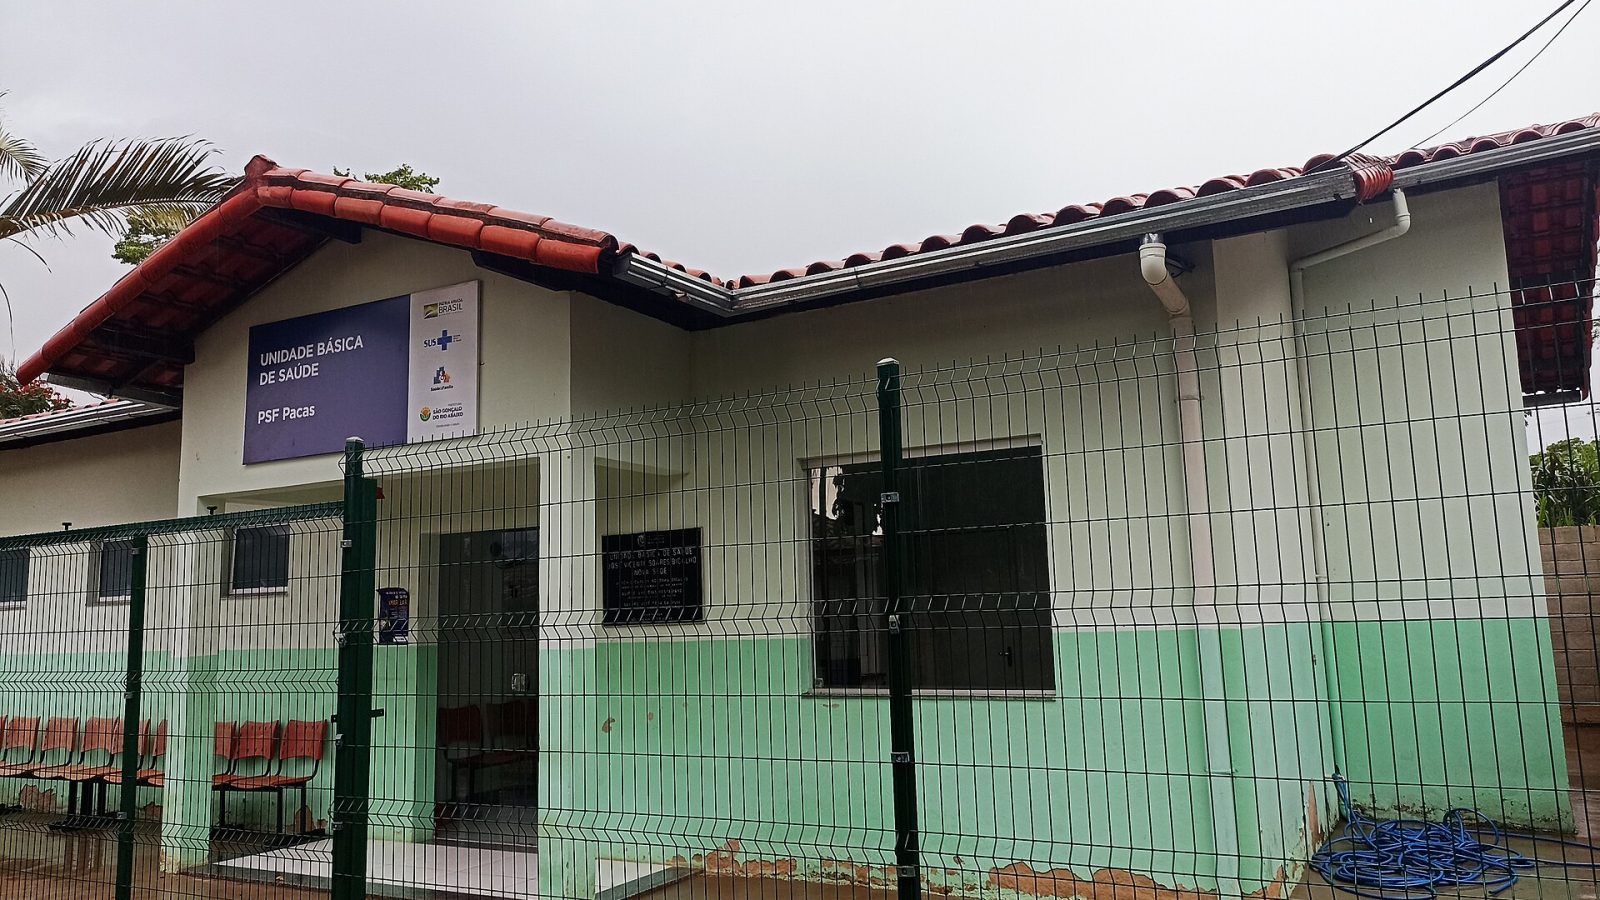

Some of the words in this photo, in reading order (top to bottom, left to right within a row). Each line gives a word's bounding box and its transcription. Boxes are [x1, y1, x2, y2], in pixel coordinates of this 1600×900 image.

[439, 303, 463, 313] BRASIL
[260, 344, 314, 366] UNIDADE
[317, 335, 364, 356] BÁSICA
[423, 339, 437, 348] SUS
[259, 371, 276, 386] DE
[278, 363, 319, 382] SAÚDE
[257, 408, 279, 424] PSF
[282, 405, 316, 420] Pacas
